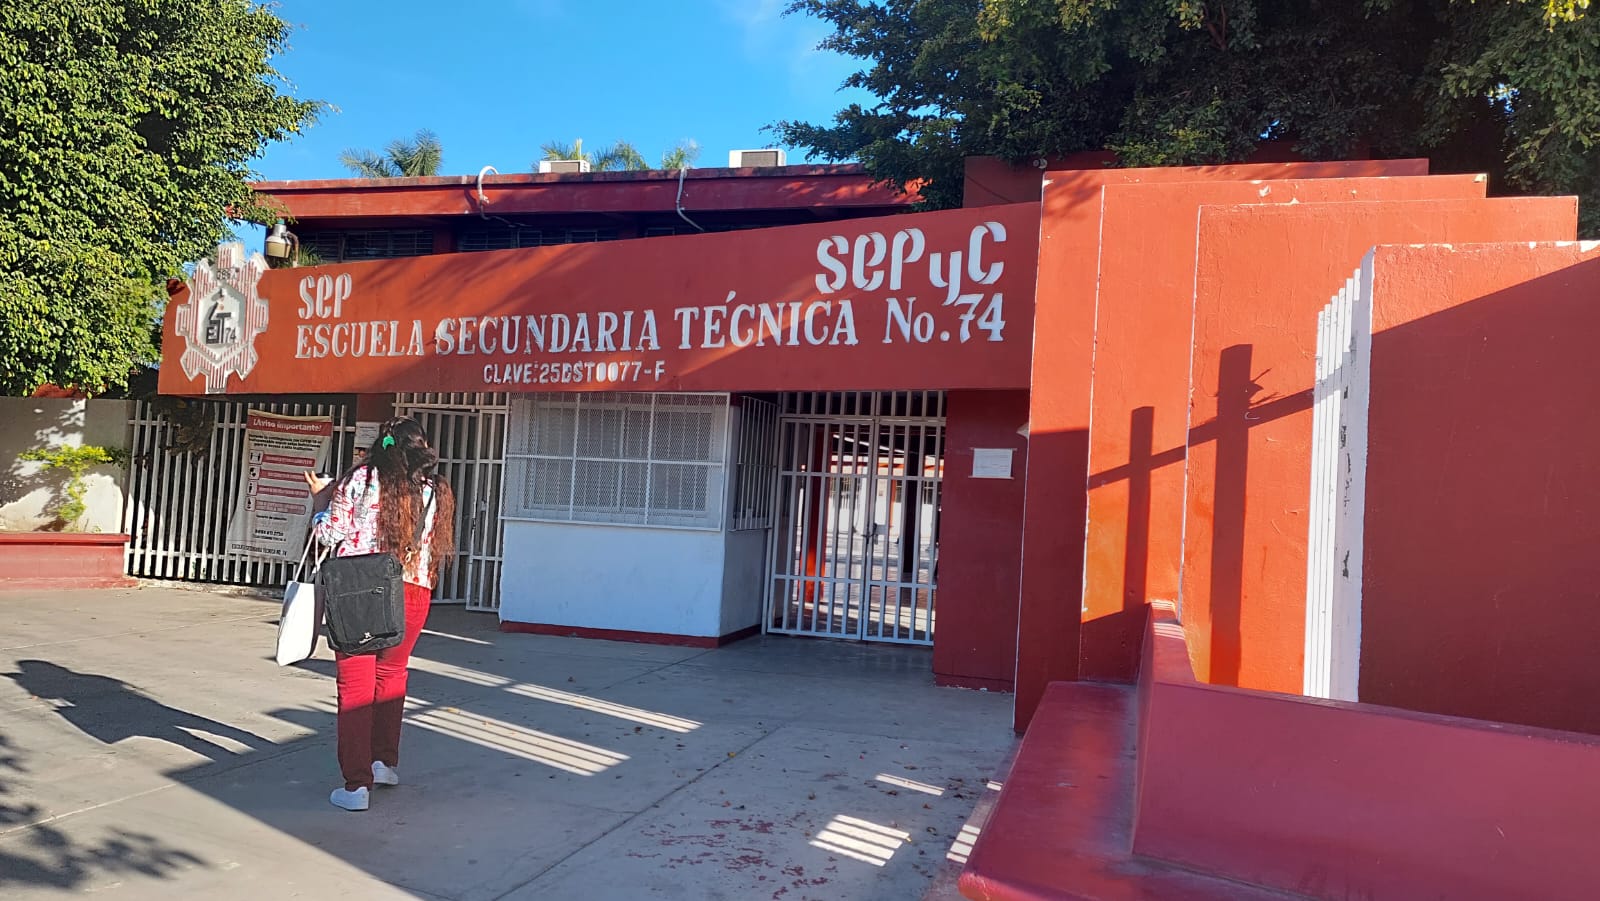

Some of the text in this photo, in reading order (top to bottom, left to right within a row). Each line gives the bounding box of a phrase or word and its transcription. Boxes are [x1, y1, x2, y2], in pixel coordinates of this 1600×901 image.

[294, 318, 425, 359] ESCUELA
[434, 309, 662, 356] SECUNDARIA
[673, 290, 858, 350] TÉCNICA
